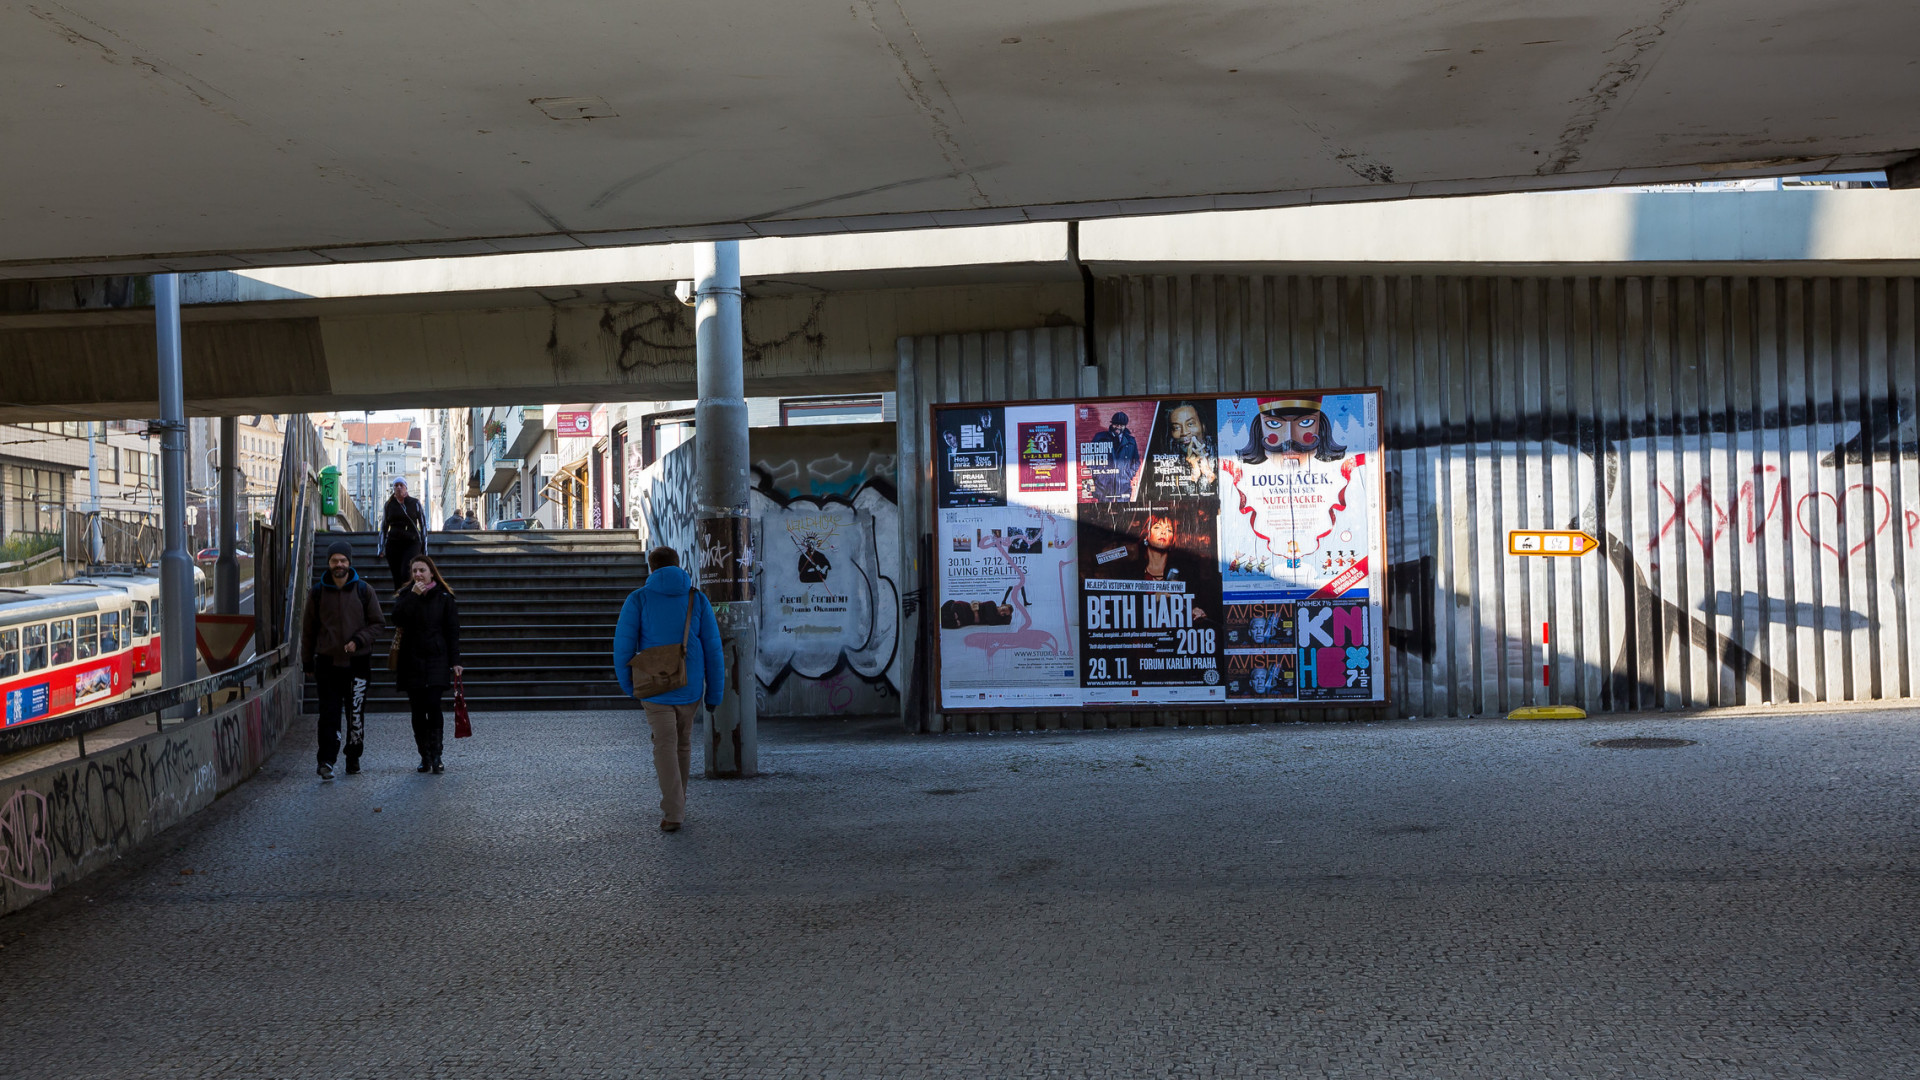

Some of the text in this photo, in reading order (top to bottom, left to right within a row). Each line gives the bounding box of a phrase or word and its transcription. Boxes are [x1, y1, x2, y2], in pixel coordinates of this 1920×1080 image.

[1080, 442, 1113, 454] GREGORY
[1080, 454, 1108, 466] PORTER
[948, 558, 972, 566] 30.10.
[984, 557, 1004, 566] 17.12.
[948, 568, 978, 576] LIVING
[1087, 580, 1108, 589] NEJLEPŠÍ
[1108, 581, 1134, 589] VSTUPENKY
[1156, 582, 1170, 591] PRÁVĚ
[1333, 570, 1364, 595] VINOHRADECH
[1087, 594, 1195, 629] BETH HART
[1227, 604, 1293, 618] AVISHAI
[1298, 606, 1369, 647] KNI
[1176, 629, 1215, 654] 2018
[1089, 658, 1111, 679] 29.
[1115, 658, 1132, 679] 11.
[1140, 655, 1216, 670] FORUM KARLÍN PRAHA
[1228, 654, 1294, 669] AVISHAI
